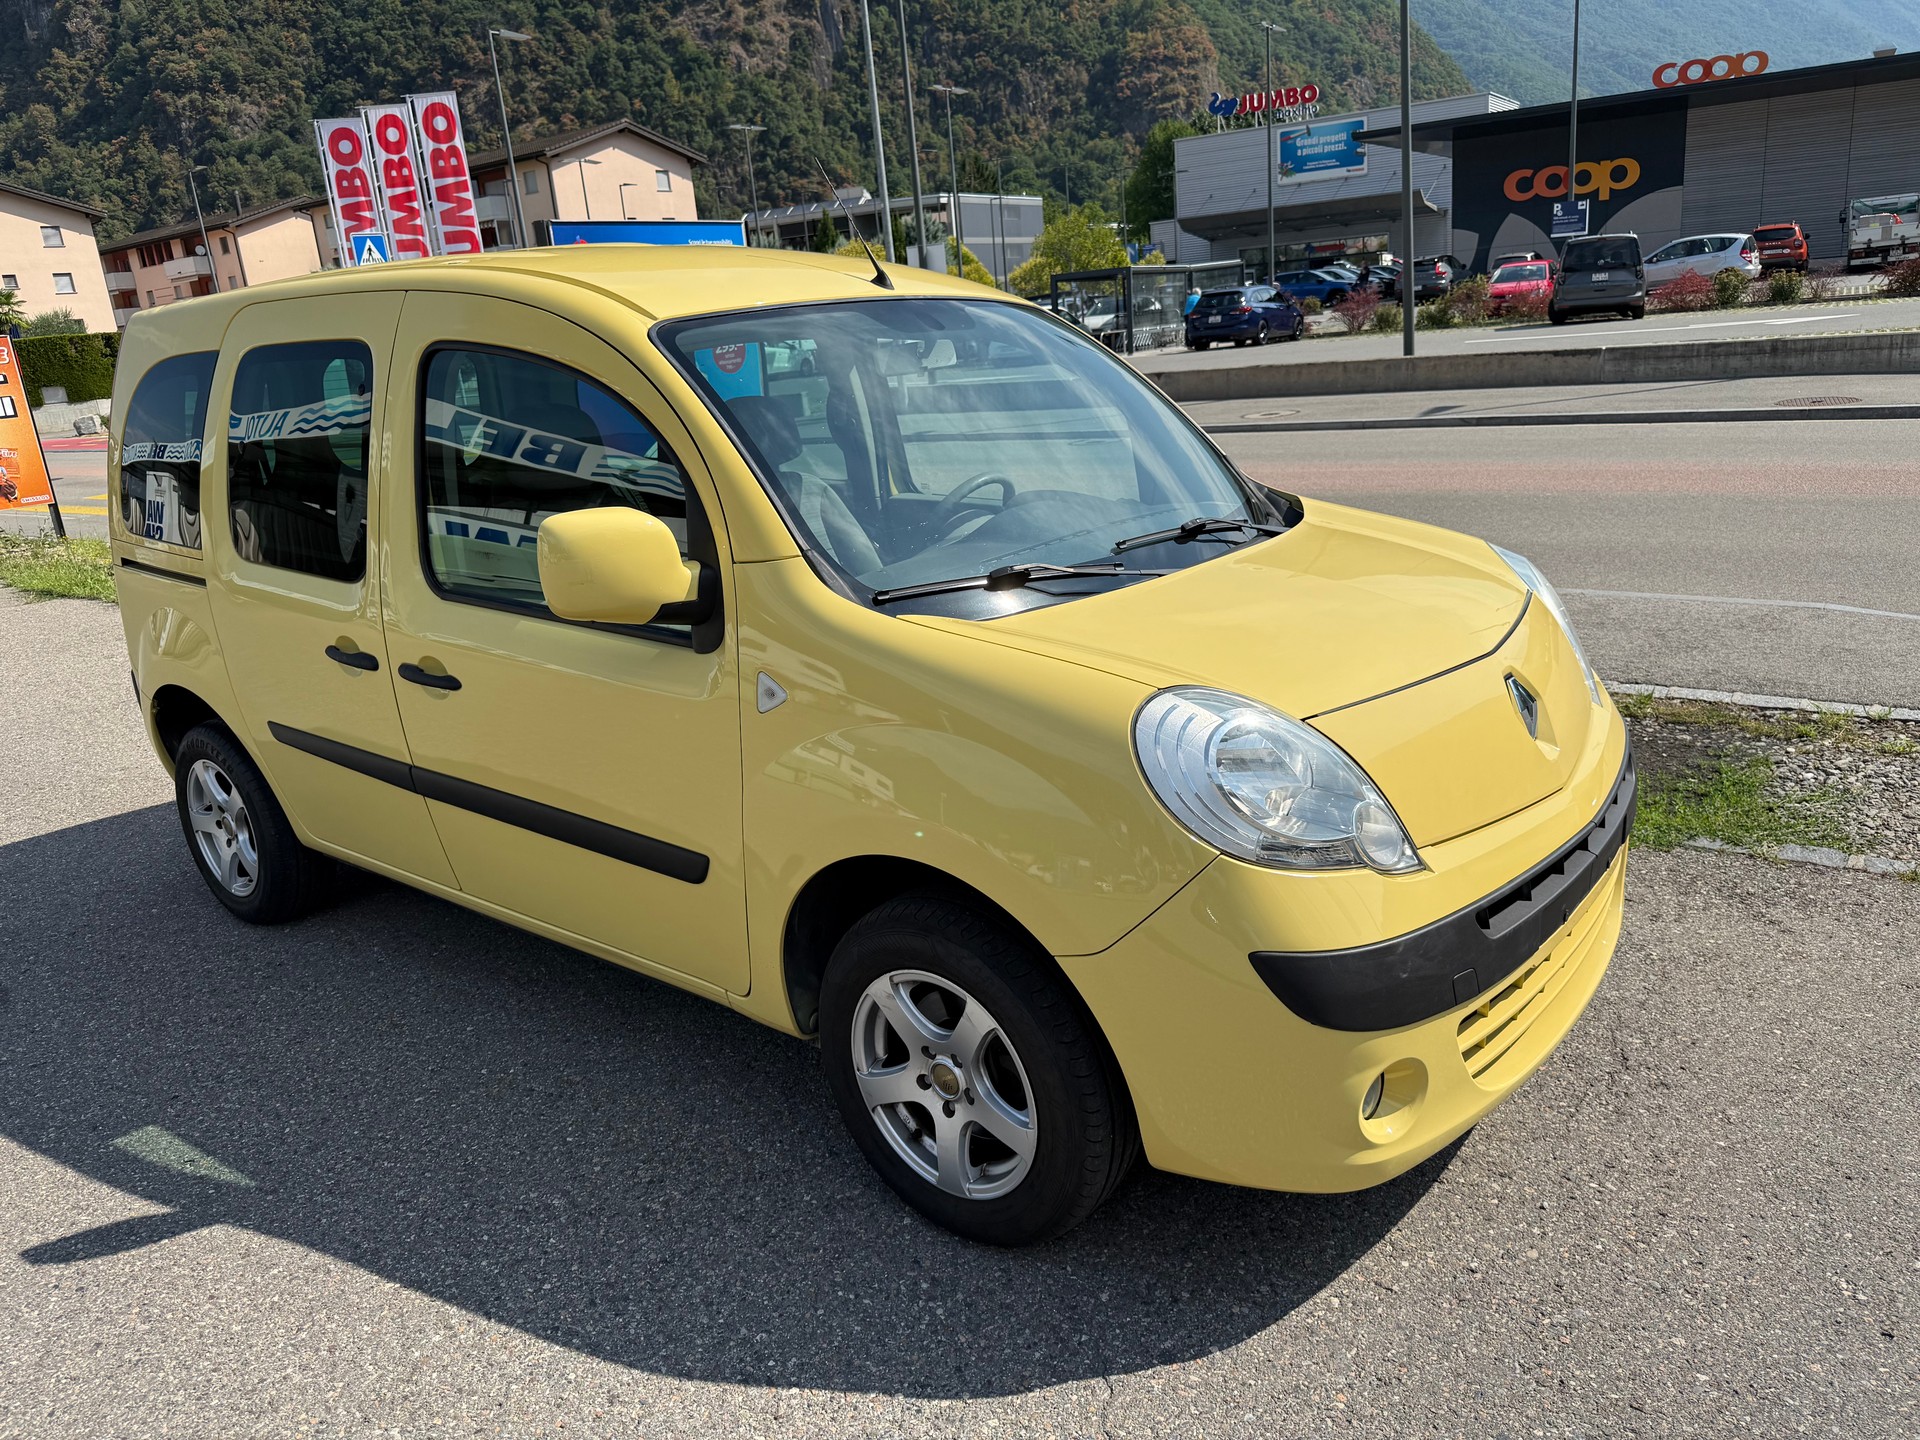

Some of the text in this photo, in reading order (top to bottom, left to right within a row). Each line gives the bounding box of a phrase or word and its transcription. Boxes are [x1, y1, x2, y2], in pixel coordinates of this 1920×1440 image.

[1652, 51, 1769, 88] coop
[1237, 84, 1319, 114] JUMBO
[1296, 132, 1346, 146] Grandi progetti
[1303, 144, 1323, 156] piccoli
[1503, 157, 1640, 201] coop
[1553, 203, 1562, 215] P
